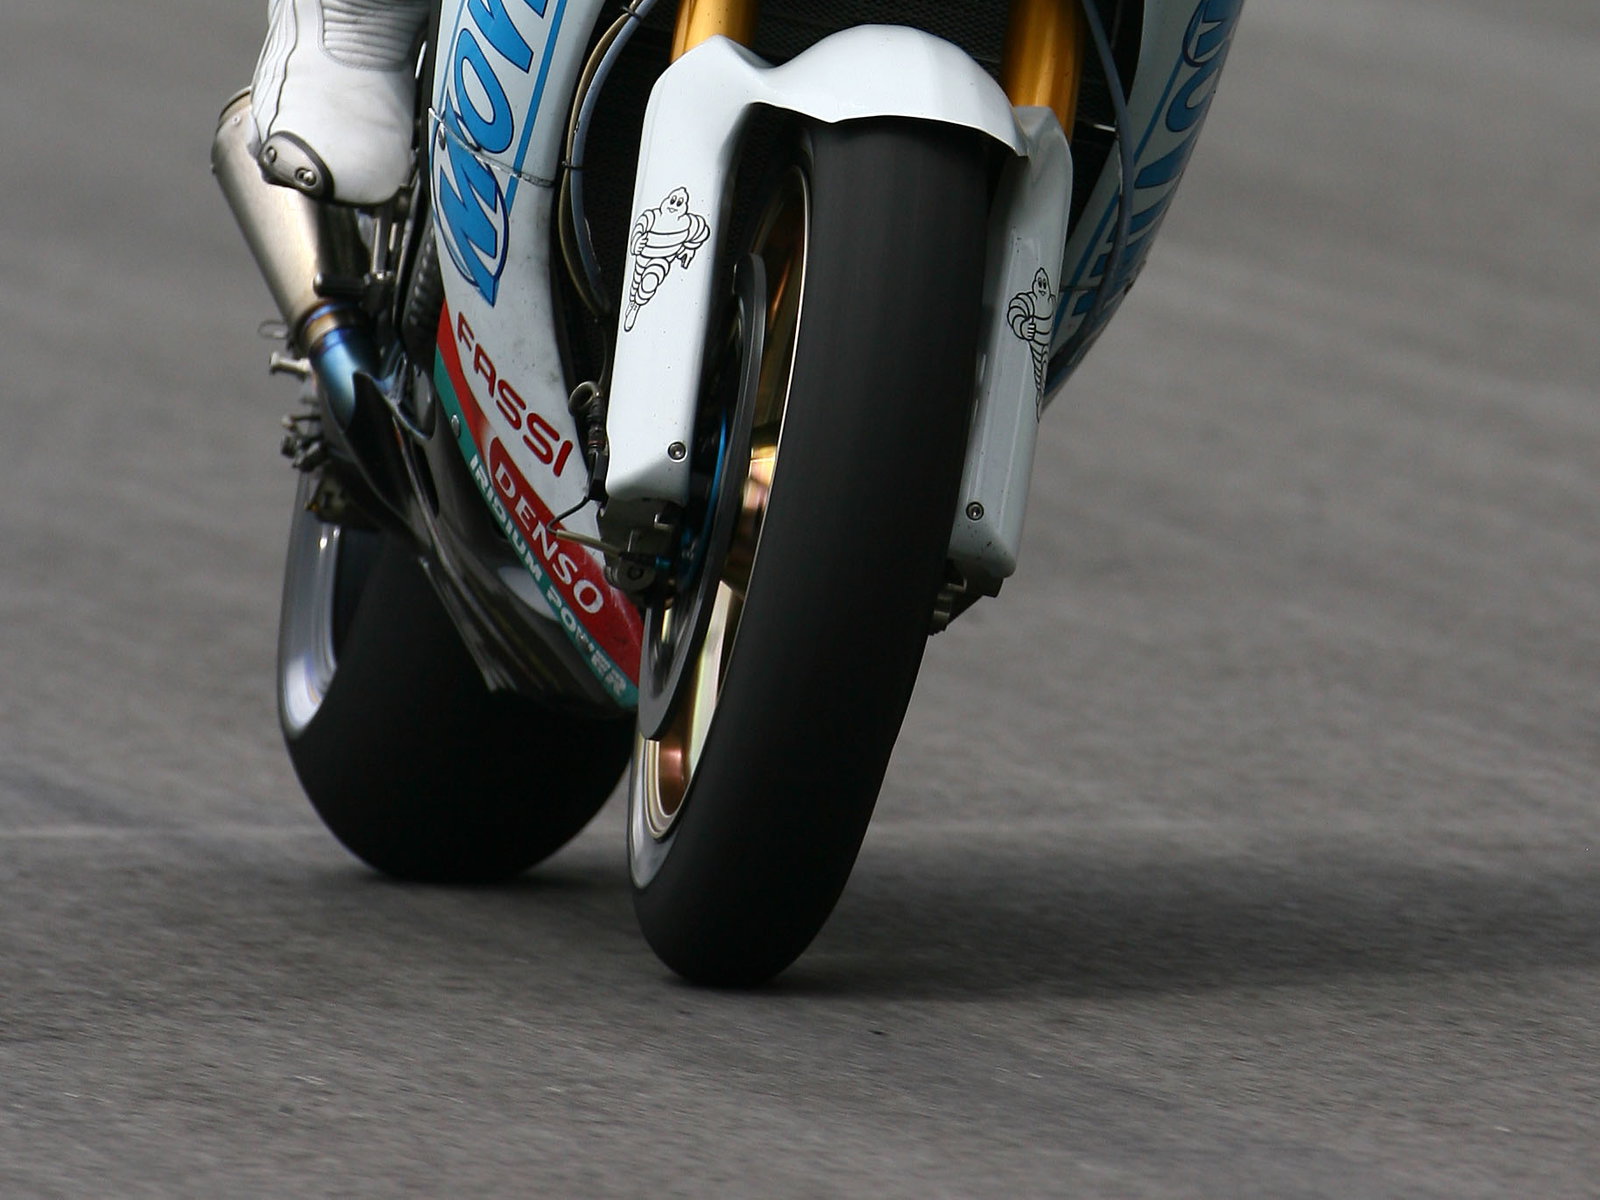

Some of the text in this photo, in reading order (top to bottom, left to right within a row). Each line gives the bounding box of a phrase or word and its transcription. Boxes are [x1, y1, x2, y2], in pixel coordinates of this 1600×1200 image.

[456, 310, 573, 478] FASSI
[470, 454, 543, 583] IRIDIUM
[495, 462, 604, 614] DENSO
